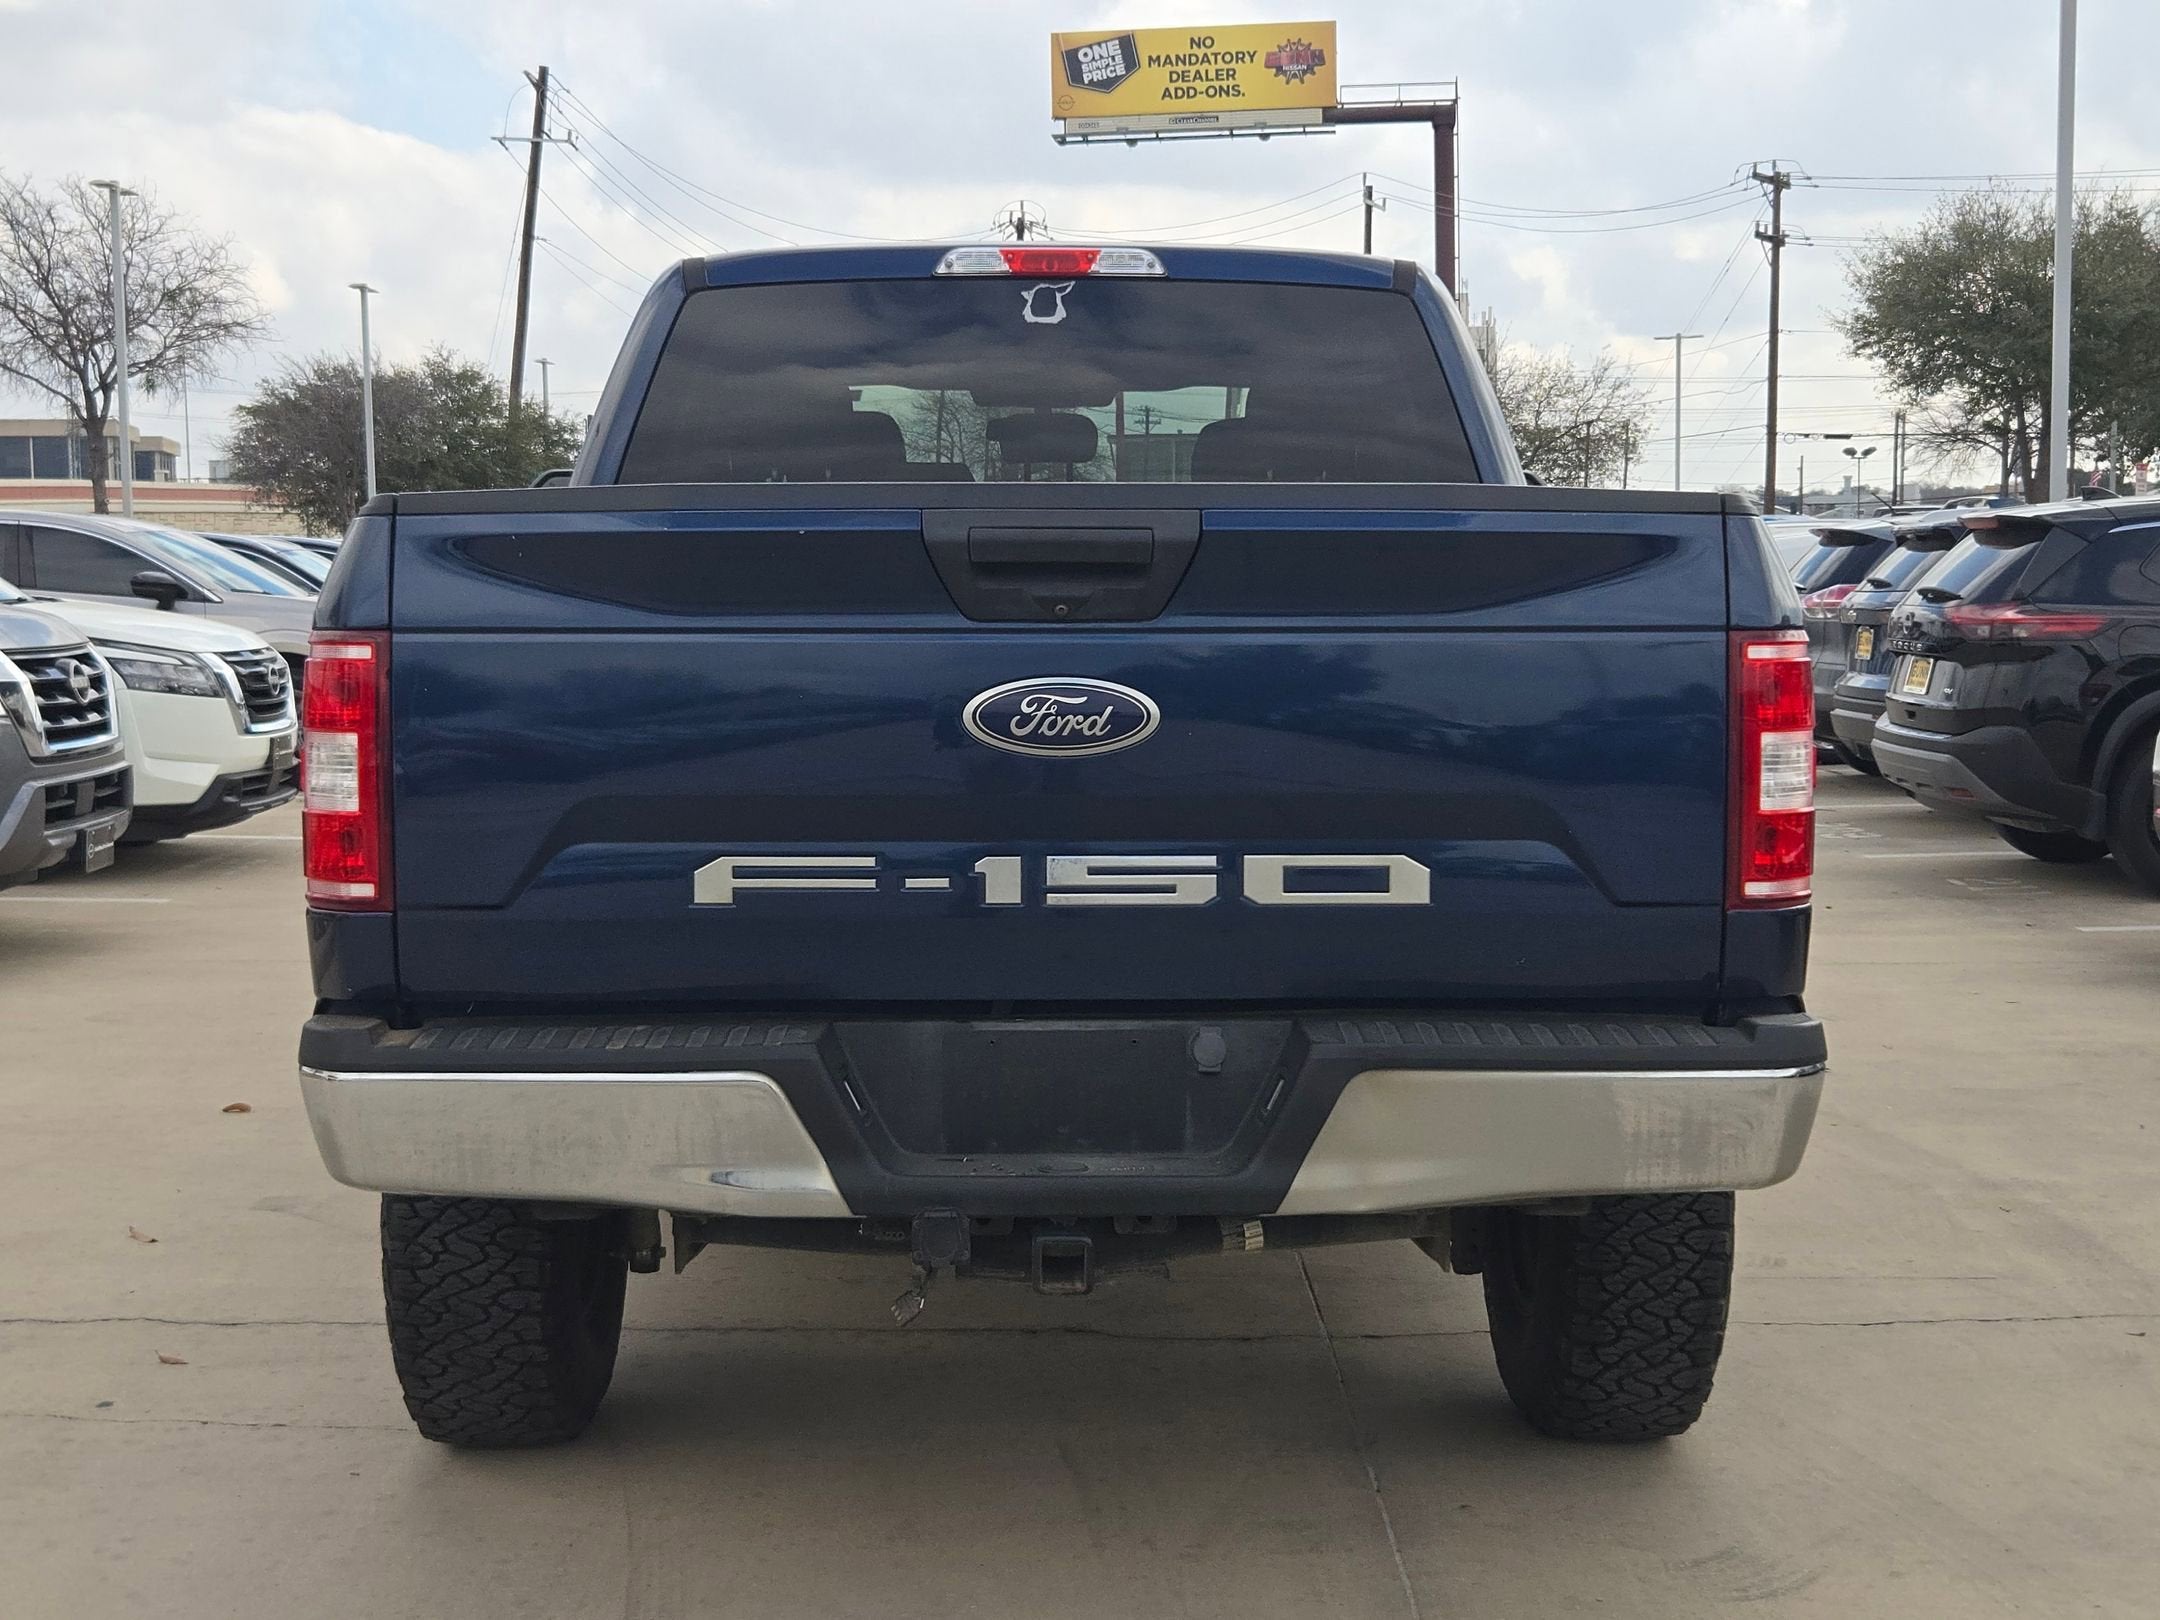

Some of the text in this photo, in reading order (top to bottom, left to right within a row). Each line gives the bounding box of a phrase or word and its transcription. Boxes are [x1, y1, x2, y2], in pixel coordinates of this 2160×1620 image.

[1078, 40, 1121, 63] ONE
[1189, 36, 1215, 50] NO
[1081, 55, 1123, 73] SIMPLE
[1147, 50, 1258, 68] MANDATORY
[1082, 64, 1126, 84] PRICE
[1168, 68, 1237, 83] DEALER
[1161, 84, 1246, 100] ADD-ONS.
[1010, 694, 1113, 736] Ford
[693, 854, 1432, 906] F-150
